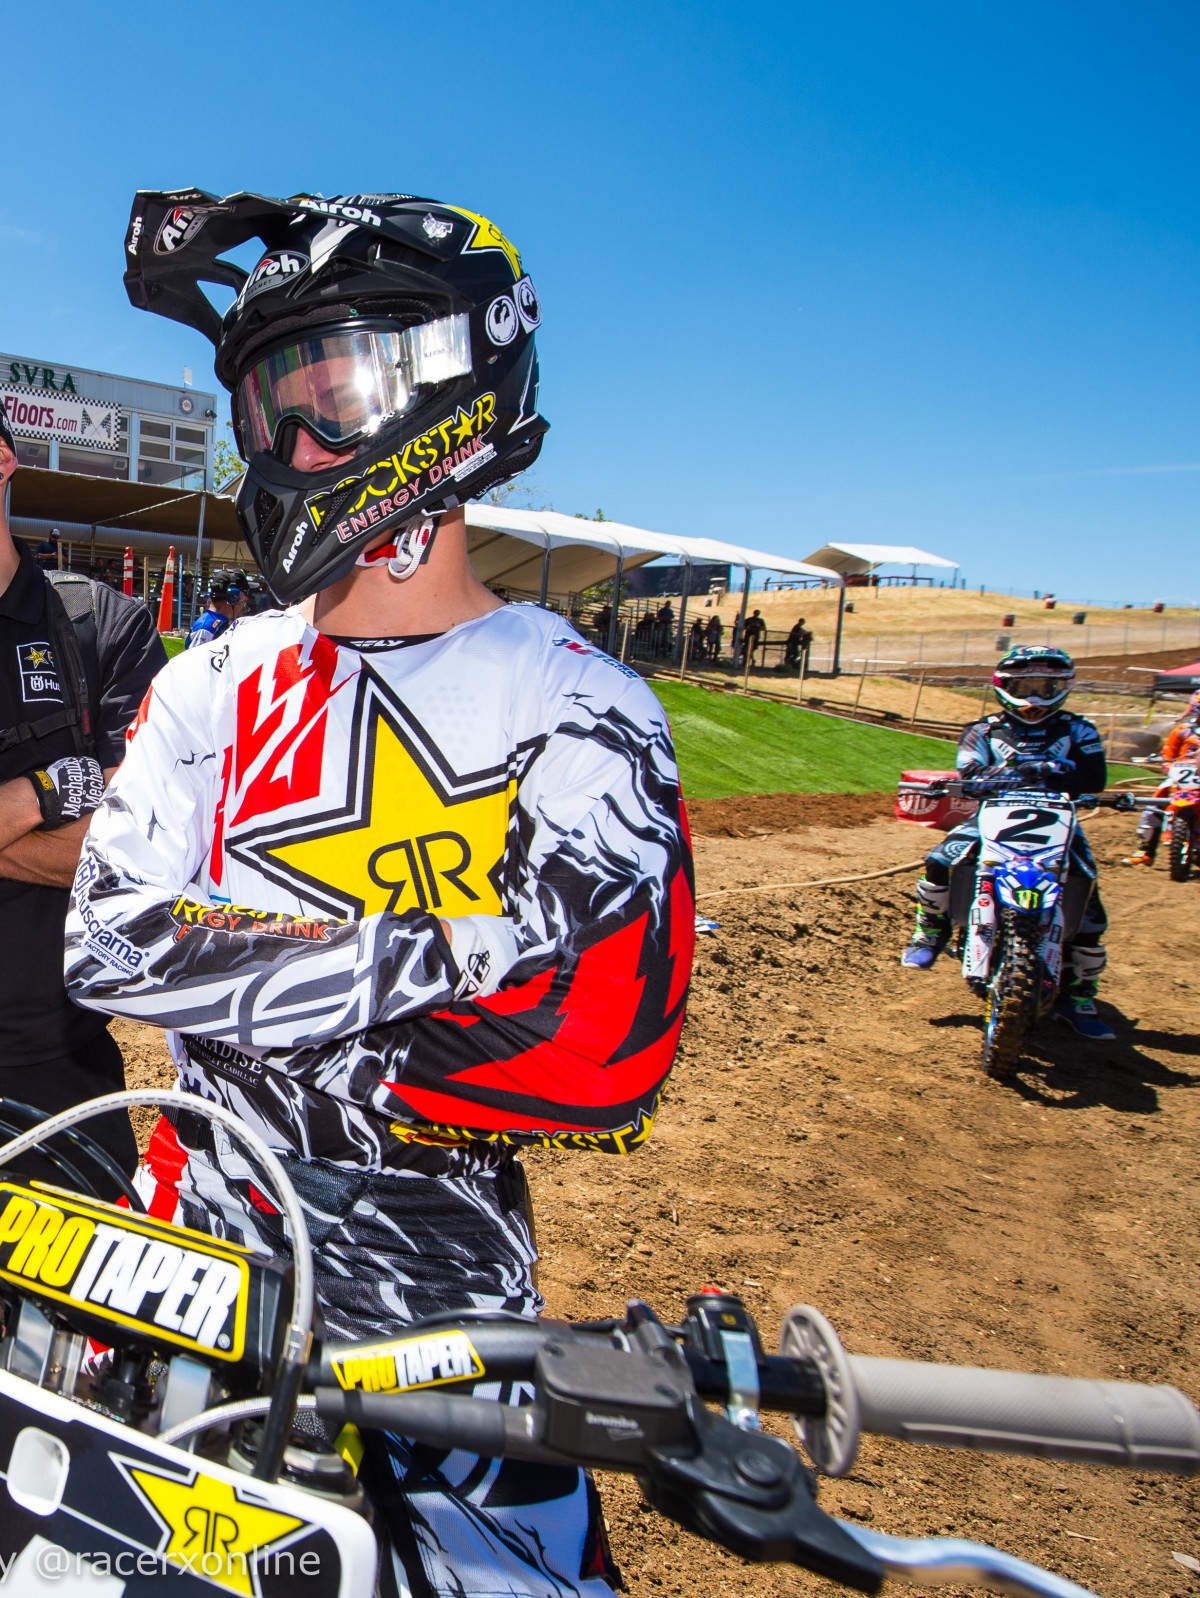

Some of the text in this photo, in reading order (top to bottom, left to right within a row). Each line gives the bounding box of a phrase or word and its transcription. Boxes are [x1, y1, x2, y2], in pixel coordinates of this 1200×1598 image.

[299, 200, 382, 227] Airoh
[127, 216, 143, 256] Airoh
[9, 362, 78, 394] SVRA
[336, 478, 421, 540] ENERGY
[428, 433, 489, 485] DRINK
[282, 521, 308, 574] Airoh
[994, 808, 1060, 845] 2
[77, 886, 144, 969] Husqvarna
[252, 920, 329, 940] DRINK
[84, 941, 135, 977] FACTORY RACING
[223, 1063, 259, 1086] CADILLAC
